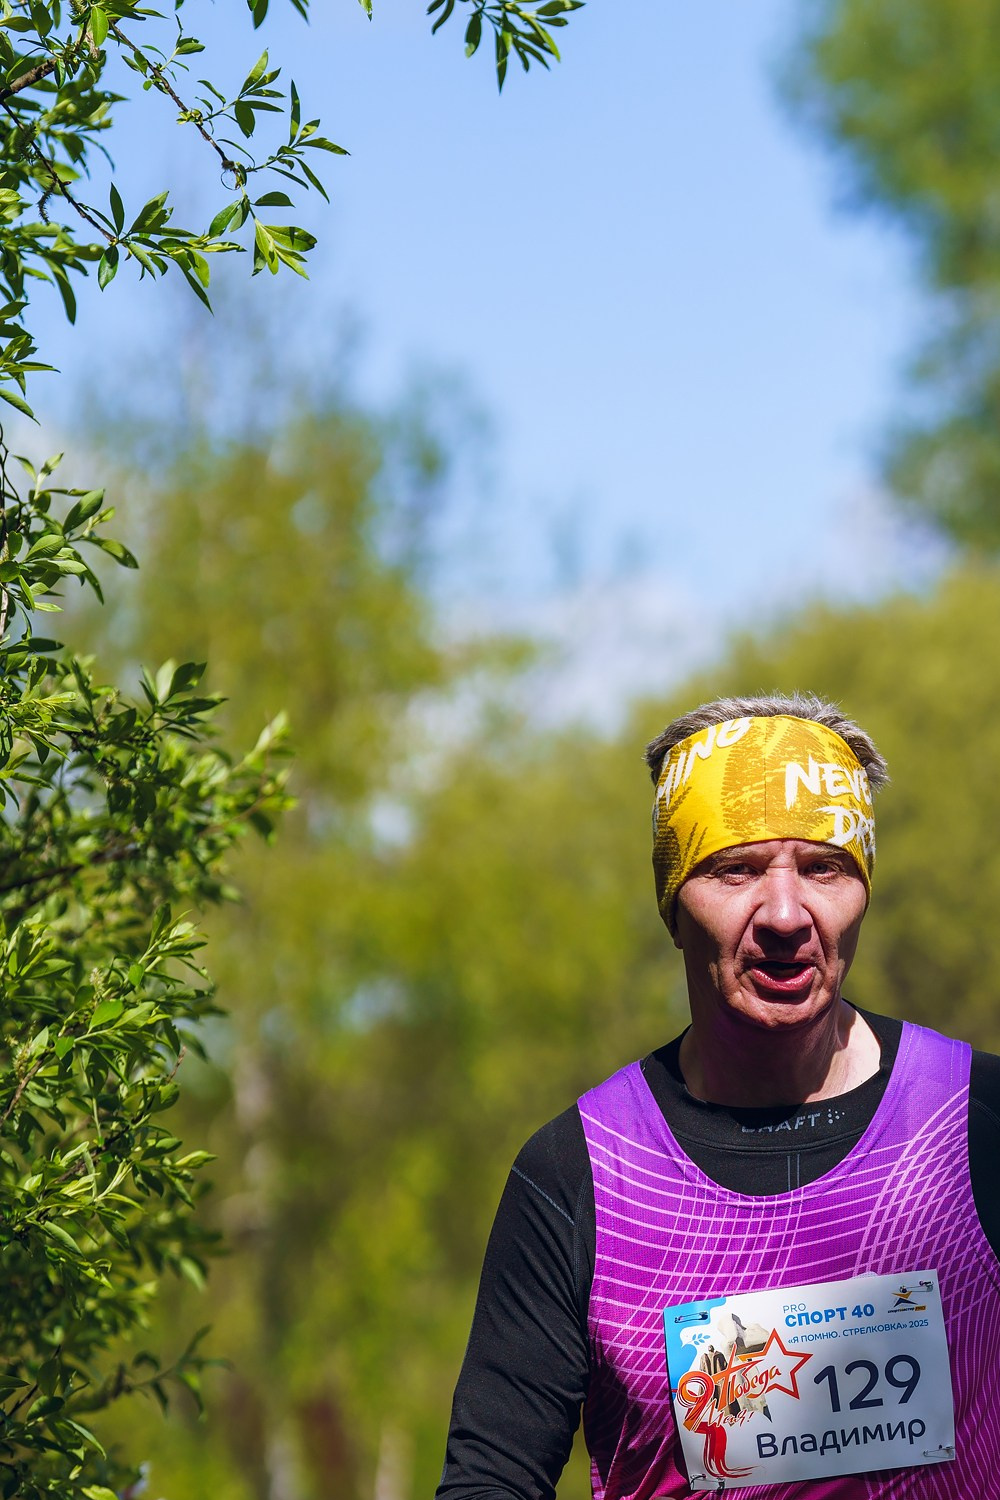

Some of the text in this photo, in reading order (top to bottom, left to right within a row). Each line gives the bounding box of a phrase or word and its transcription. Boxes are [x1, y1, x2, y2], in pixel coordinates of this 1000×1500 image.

[782, 1302, 807, 1314] PRO
[785, 1303, 875, 1328] СПОРТ 40
[800, 1330, 841, 1343] ПОМНЮ.
[842, 1322, 908, 1337] СТРЕЛКОВКА»
[908, 1318, 929, 1328] 2025
[813, 1354, 921, 1413] 129
[756, 1418, 926, 1459] Владимир
